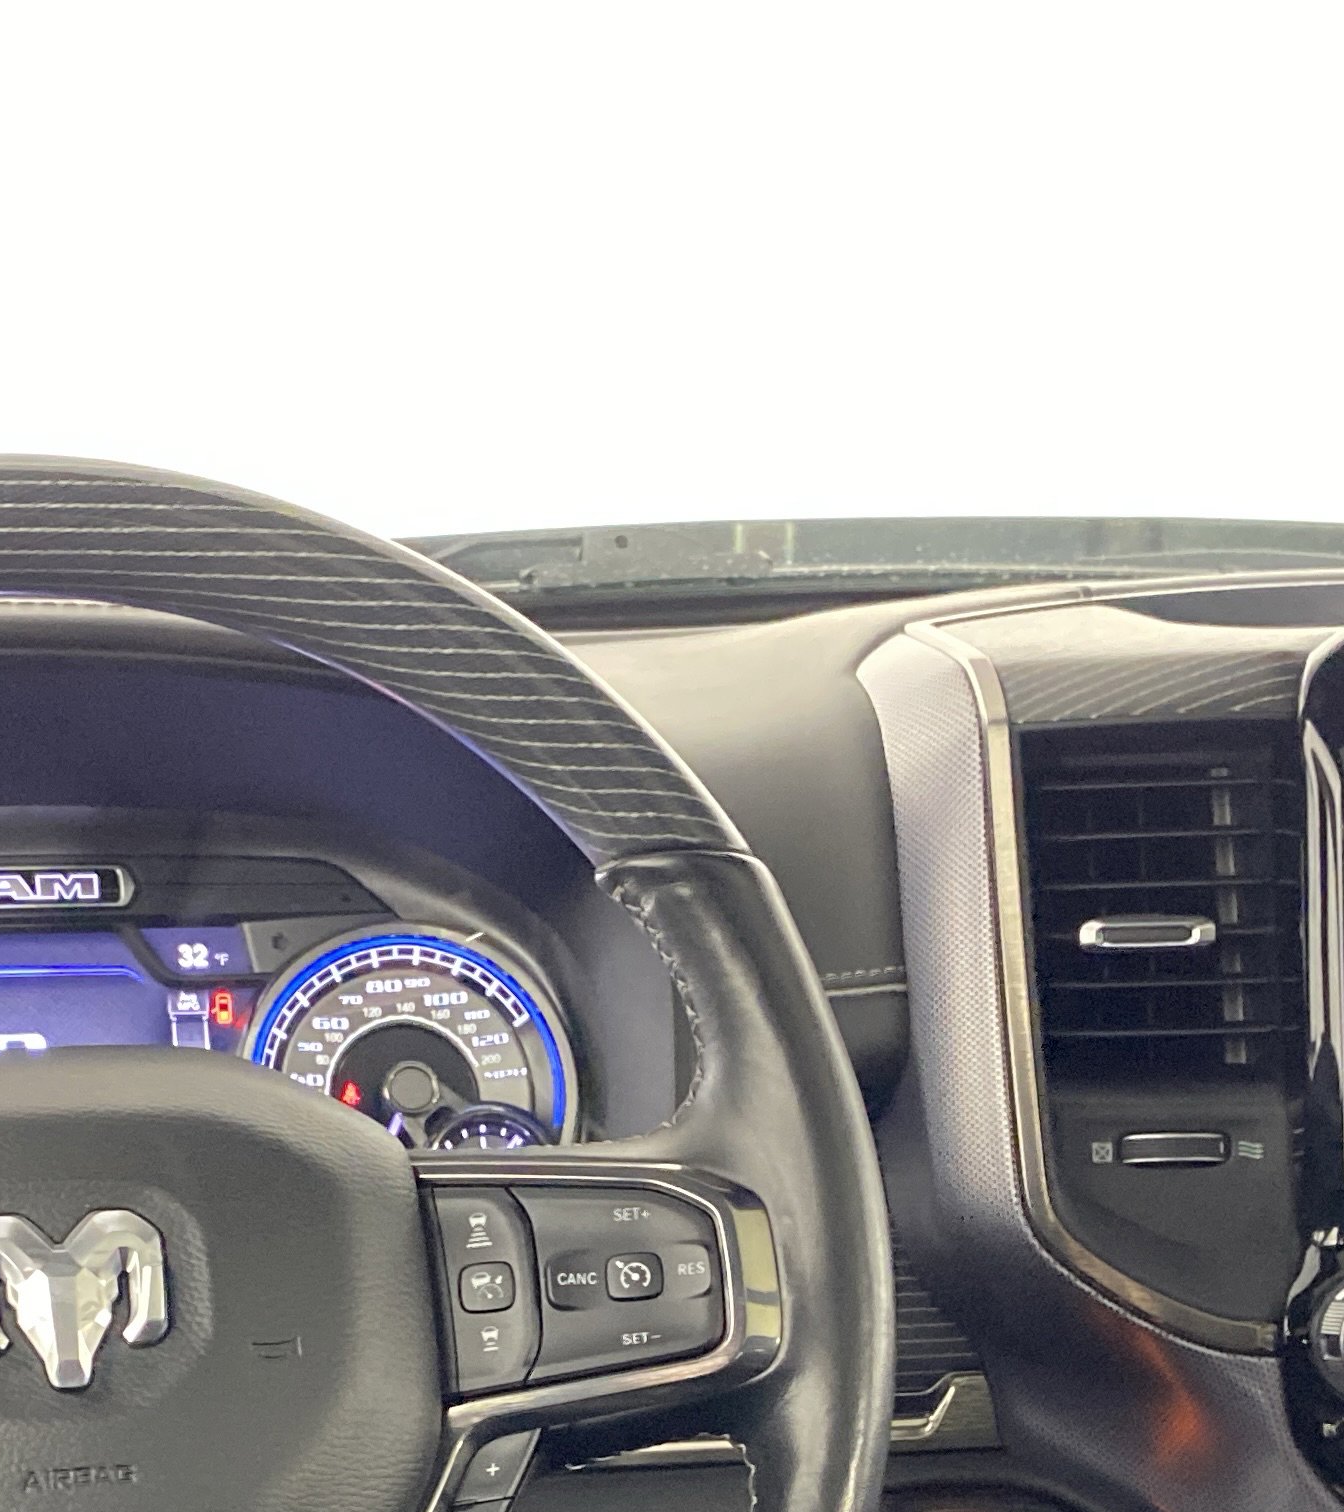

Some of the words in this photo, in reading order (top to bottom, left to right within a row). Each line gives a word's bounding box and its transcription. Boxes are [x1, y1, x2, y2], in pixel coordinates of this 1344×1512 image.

[177, 943, 208, 968] 32
[365, 979, 403, 993] 80
[338, 994, 363, 1006] 70
[423, 991, 468, 1006] 100
[312, 1016, 349, 1031] 60
[471, 1033, 509, 1047] 120
[677, 1261, 706, 1276] RES
[556, 1272, 598, 1287] CANC
[23, 1463, 139, 1494] AIRBAG
